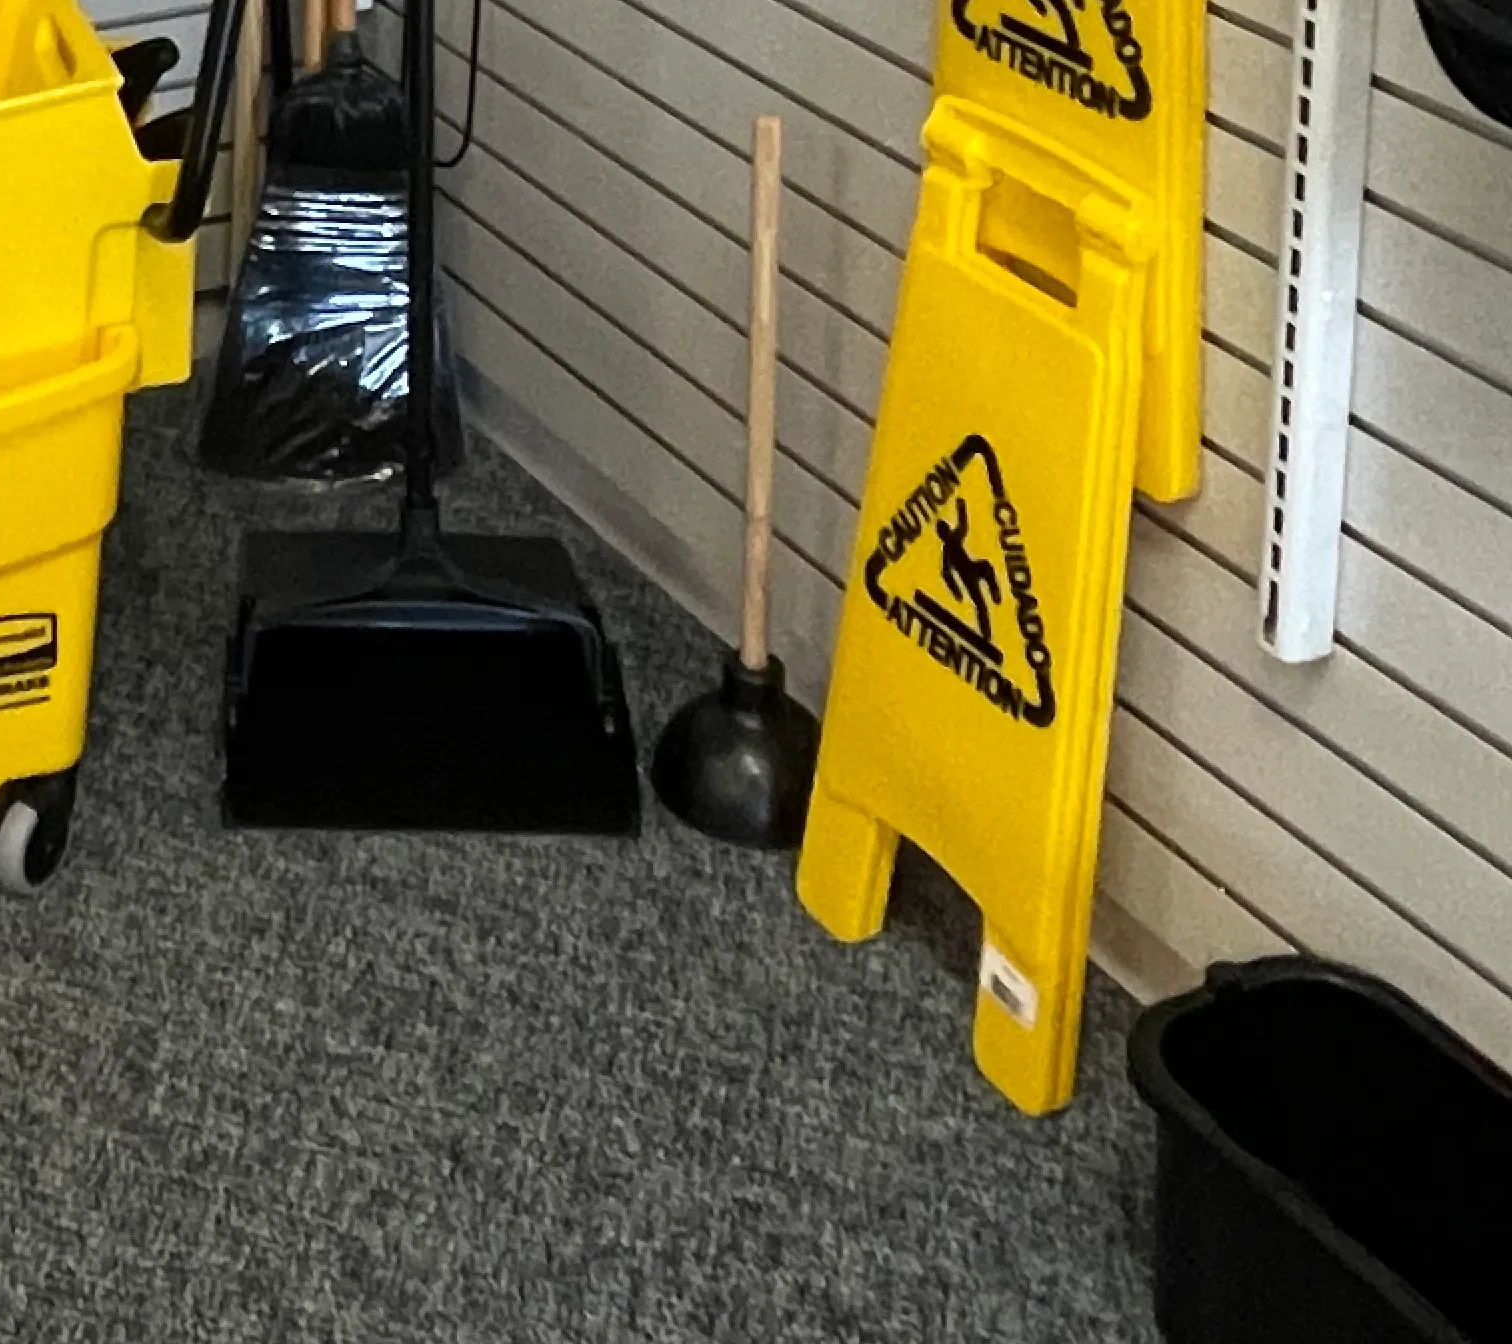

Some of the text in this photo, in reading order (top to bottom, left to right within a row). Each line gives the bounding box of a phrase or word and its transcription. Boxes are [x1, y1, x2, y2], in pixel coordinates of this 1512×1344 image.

[975, 23, 1120, 120] ATTENTION
[878, 456, 961, 563] CAUTION
[993, 500, 1052, 669] CUIDADO
[886, 595, 1025, 722] ATTENTION
